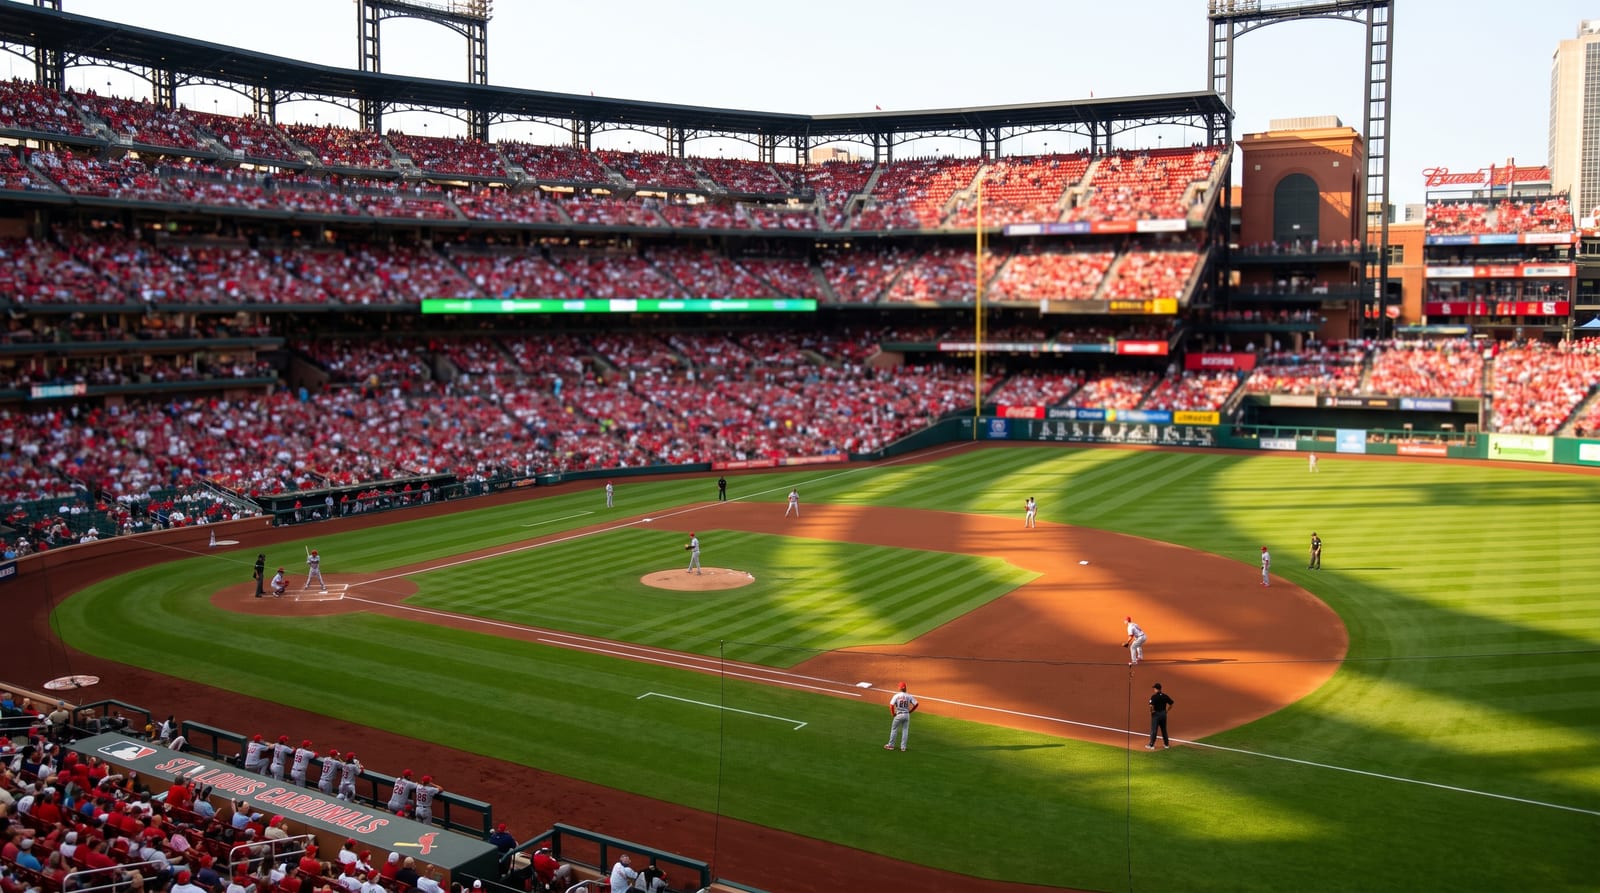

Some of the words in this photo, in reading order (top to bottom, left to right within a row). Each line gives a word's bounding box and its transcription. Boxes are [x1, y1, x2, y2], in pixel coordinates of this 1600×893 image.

[154, 757, 200, 776] ST.
[193, 768, 267, 796] LOUIS
[253, 787, 390, 834] CARDINALS
